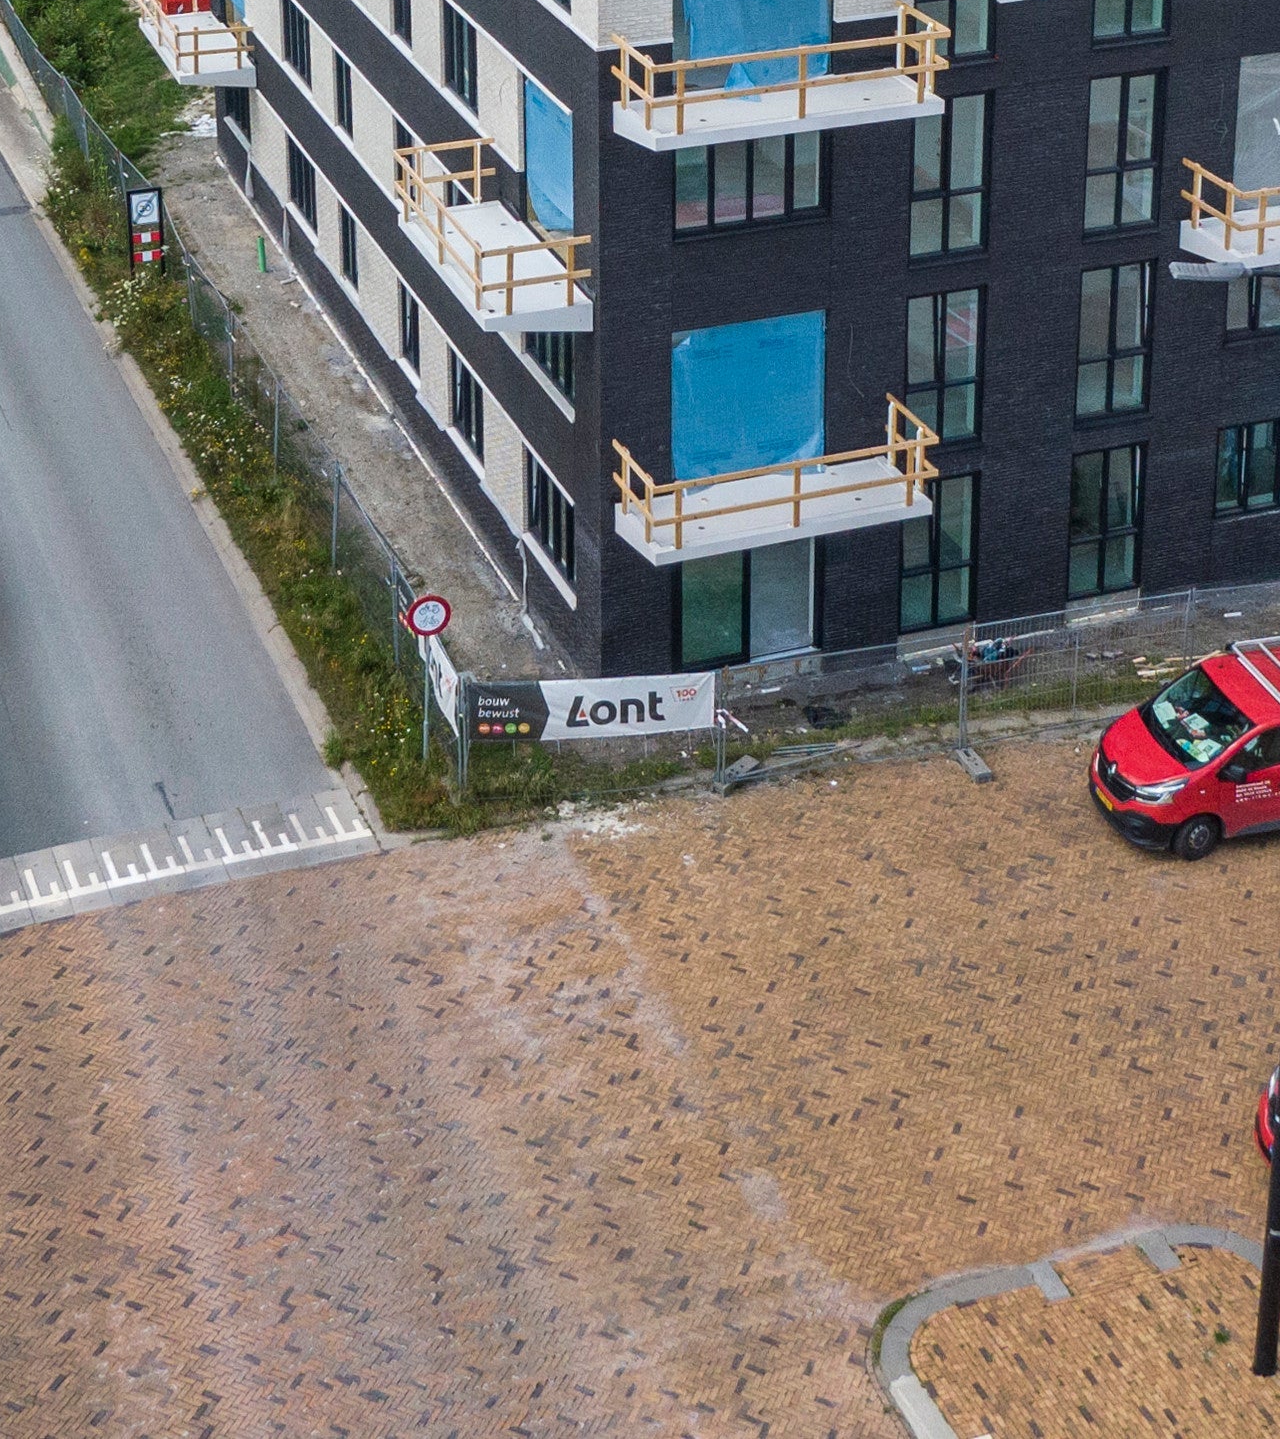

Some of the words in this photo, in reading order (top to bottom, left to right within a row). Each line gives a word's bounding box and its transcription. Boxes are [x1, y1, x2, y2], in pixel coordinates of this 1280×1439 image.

[676, 688, 697, 697] 100
[478, 695, 510, 706] bouw
[477, 707, 520, 718] bewust
[565, 691, 665, 728] Lont
